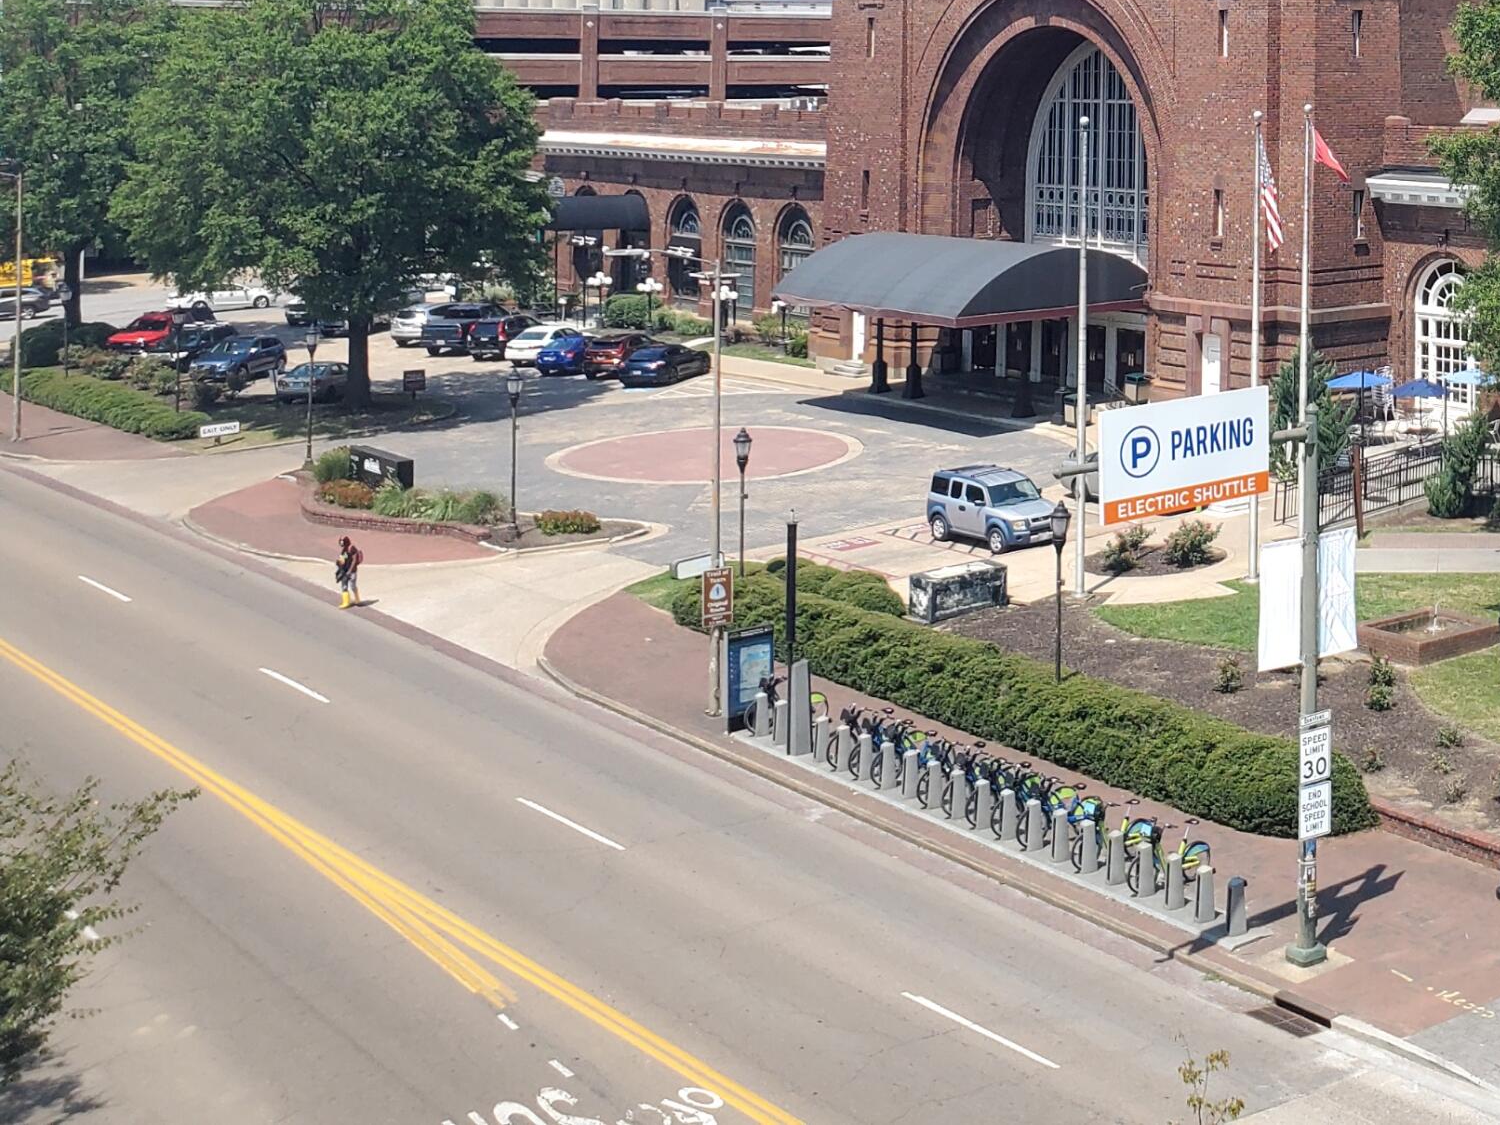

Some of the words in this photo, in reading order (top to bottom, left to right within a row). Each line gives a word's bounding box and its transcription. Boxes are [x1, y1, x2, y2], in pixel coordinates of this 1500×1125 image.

[1131, 436, 1152, 469] P
[1171, 417, 1253, 461] PARKING
[1117, 491, 1190, 518] ELECTRIC
[1193, 477, 1257, 503] SHUTTLE
[1302, 732, 1328, 746] SPEED
[1304, 744, 1325, 756] LIMIT
[1303, 757, 1327, 779] 30
[1308, 790, 1322, 800] END
[1302, 801, 1328, 813] SCHOOL
[1304, 810, 1326, 823] SPEED
[1306, 821, 1324, 833] LIMIT
